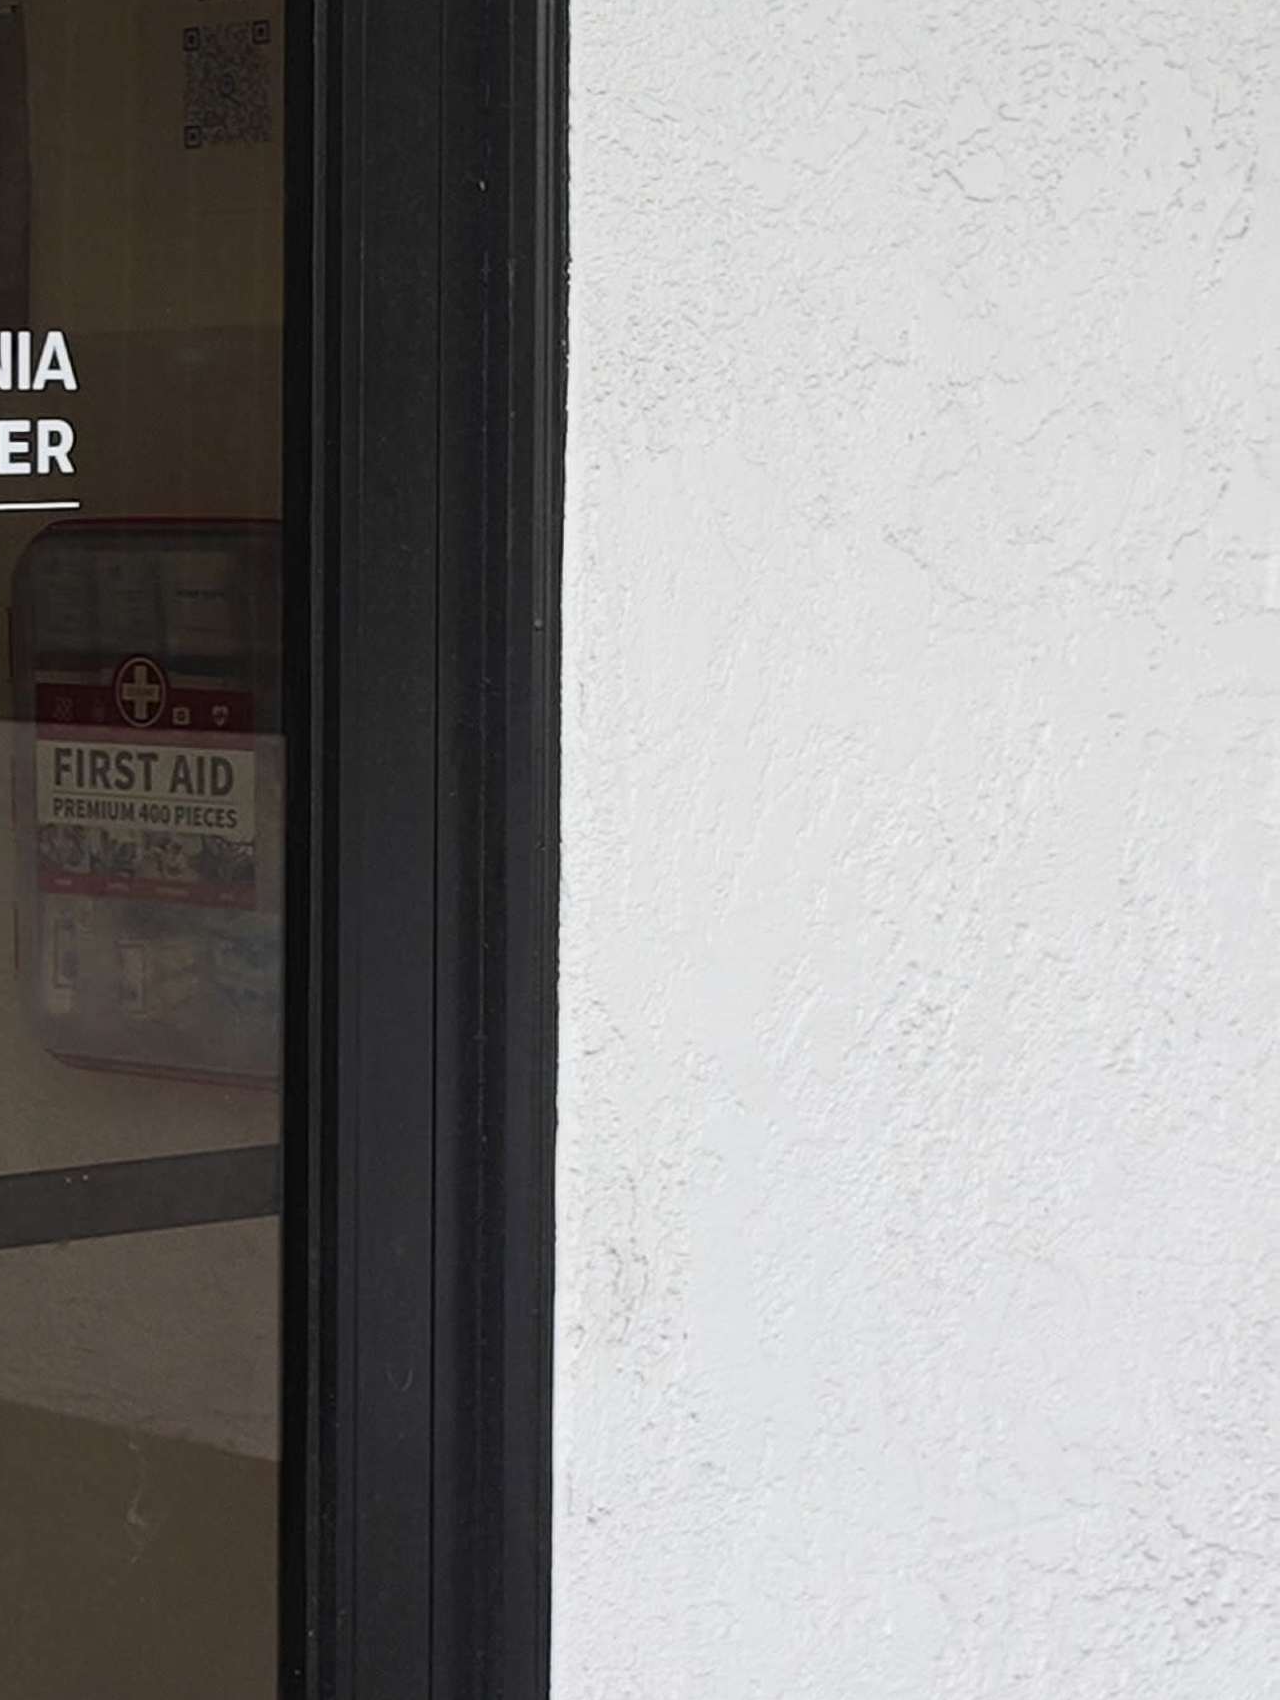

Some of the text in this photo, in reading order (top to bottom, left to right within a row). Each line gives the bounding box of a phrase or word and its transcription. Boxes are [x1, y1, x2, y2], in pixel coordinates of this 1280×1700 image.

[54, 748, 234, 796] FIRST AID
[52, 797, 238, 829] PREMIUM 400 PIECES
